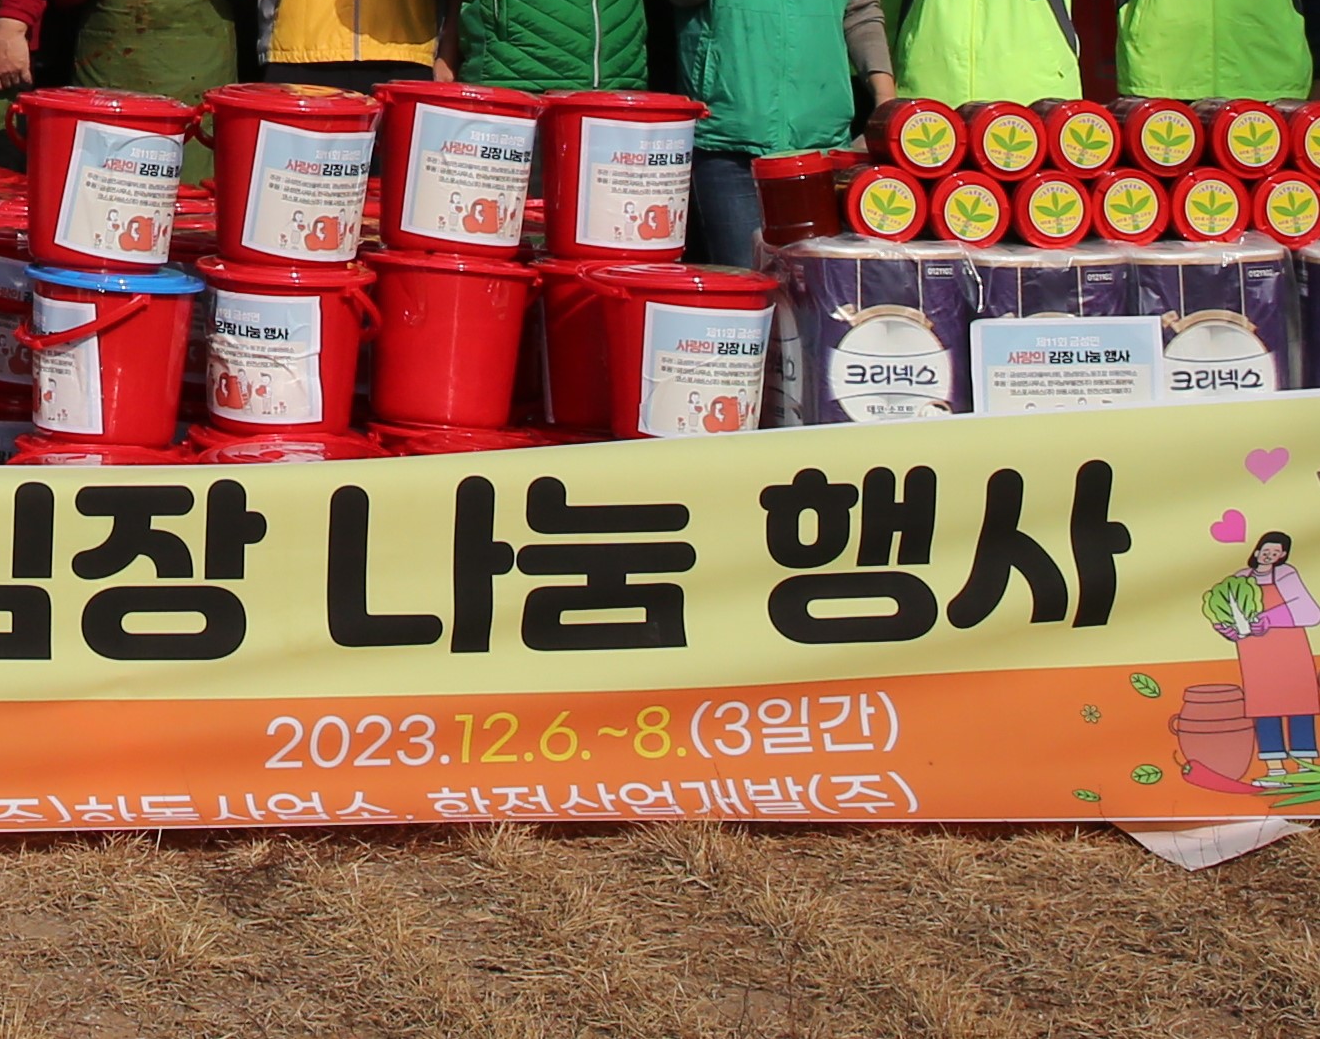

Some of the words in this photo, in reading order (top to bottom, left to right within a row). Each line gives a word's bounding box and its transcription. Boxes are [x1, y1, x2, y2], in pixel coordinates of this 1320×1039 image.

[441, 141, 477, 156] 사랑의
[480, 146, 503, 161] 김장
[612, 150, 646, 165] 사랑의
[648, 153, 668, 167] 김장
[103, 158, 137, 174] 사랑의
[139, 163, 158, 178] 김장
[286, 160, 321, 176] 사랑의
[238, 324, 261, 339] 나눔
[263, 326, 289, 341] 행사
[676, 339, 715, 354] 사랑의
[717, 342, 740, 356] 김장
[1007, 351, 1046, 365] 사랑의
[1048, 350, 1074, 365] 김장
[1076, 350, 1102, 364] 나눔
[1103, 349, 1130, 364] 행사
[844, 364, 939, 387] 크리넥스
[1170, 368, 1264, 391] 크리넥스
[326, 473, 698, 654] 나눔
[759, 458, 1134, 645] 행사
